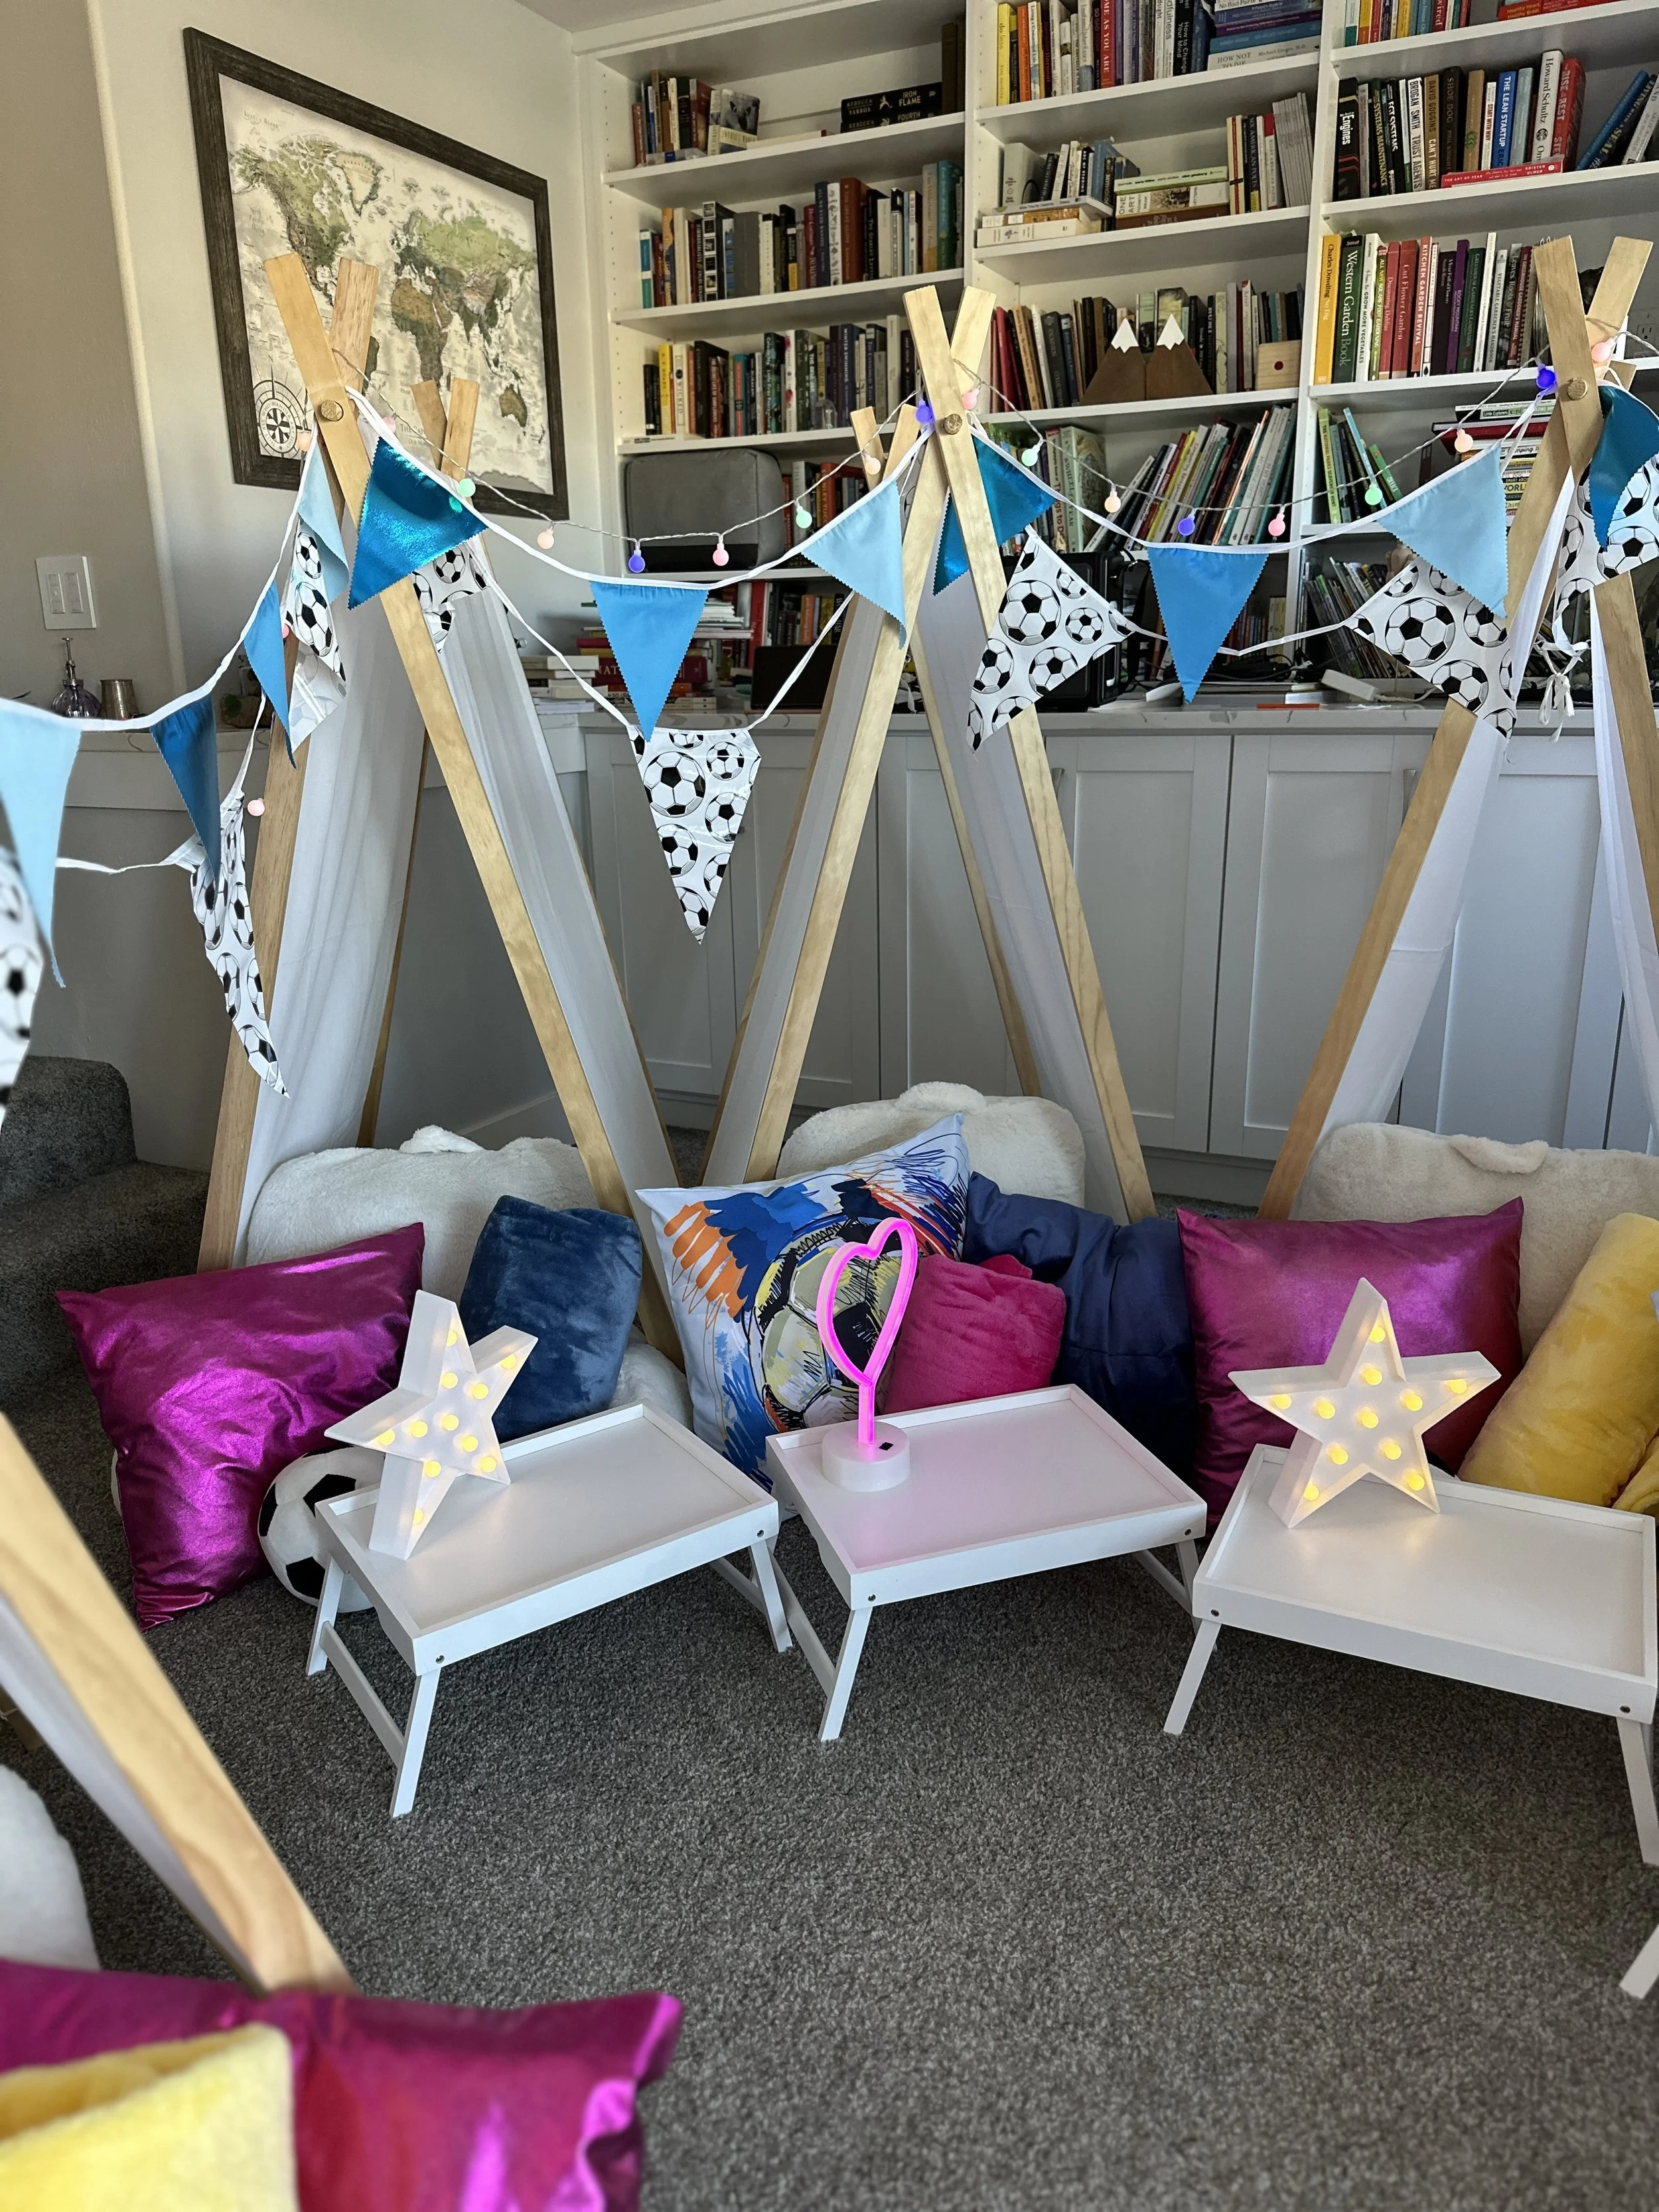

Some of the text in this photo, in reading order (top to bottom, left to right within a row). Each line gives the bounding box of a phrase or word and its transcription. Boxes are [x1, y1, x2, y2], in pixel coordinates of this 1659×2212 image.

[1103, 18, 1110, 30] AS
[1236, 52, 1251, 60] NOT
[902, 90, 917, 98] IRON
[1428, 80, 1437, 100] DAVID
[1540, 57, 1553, 124] Howard Schultz
[1556, 70, 1570, 121] RISE REST
[846, 98, 873, 108] REBECCA
[849, 107, 871, 115] YARROS
[899, 95, 921, 107] FLAME
[1501, 93, 1510, 113] LEAN
[849, 120, 875, 129] REBECCA
[897, 111, 921, 121] FOURTH
[1339, 113, 1354, 145] Engines
[1409, 80, 1423, 189] BROGAN SMITH TRUST AGENTS
[1498, 113, 1508, 147] STARTUP
[1373, 102, 1388, 188] SYSTEMS MAINTENANCE
[1428, 138, 1437, 158] CAN'T
[1429, 179, 1437, 190] ME
[818, 200, 824, 208] WE
[1323, 269, 1333, 298] Dowding
[1518, 261, 1528, 292] GREENHOUSE
[1384, 276, 1394, 310] Discovering
[1399, 281, 1409, 309] Flower
[1415, 244, 1429, 346] KITCHEN GARDEN REVIVAL
[1325, 299, 1331, 309] No
[1338, 250, 1358, 367] Western Garden Book
[1513, 292, 1524, 321] GARDENER'S
[1397, 311, 1407, 340] Garden
[1488, 273, 1502, 364] VEGETABLE GARDENER'S HANDBOOK
[765, 357, 771, 366] Ng
[261, 403, 271, 416] WHO
[271, 401, 291, 420] WANDER
[263, 433, 276, 448] NOT
[1064, 463, 1074, 490] WHEEL
